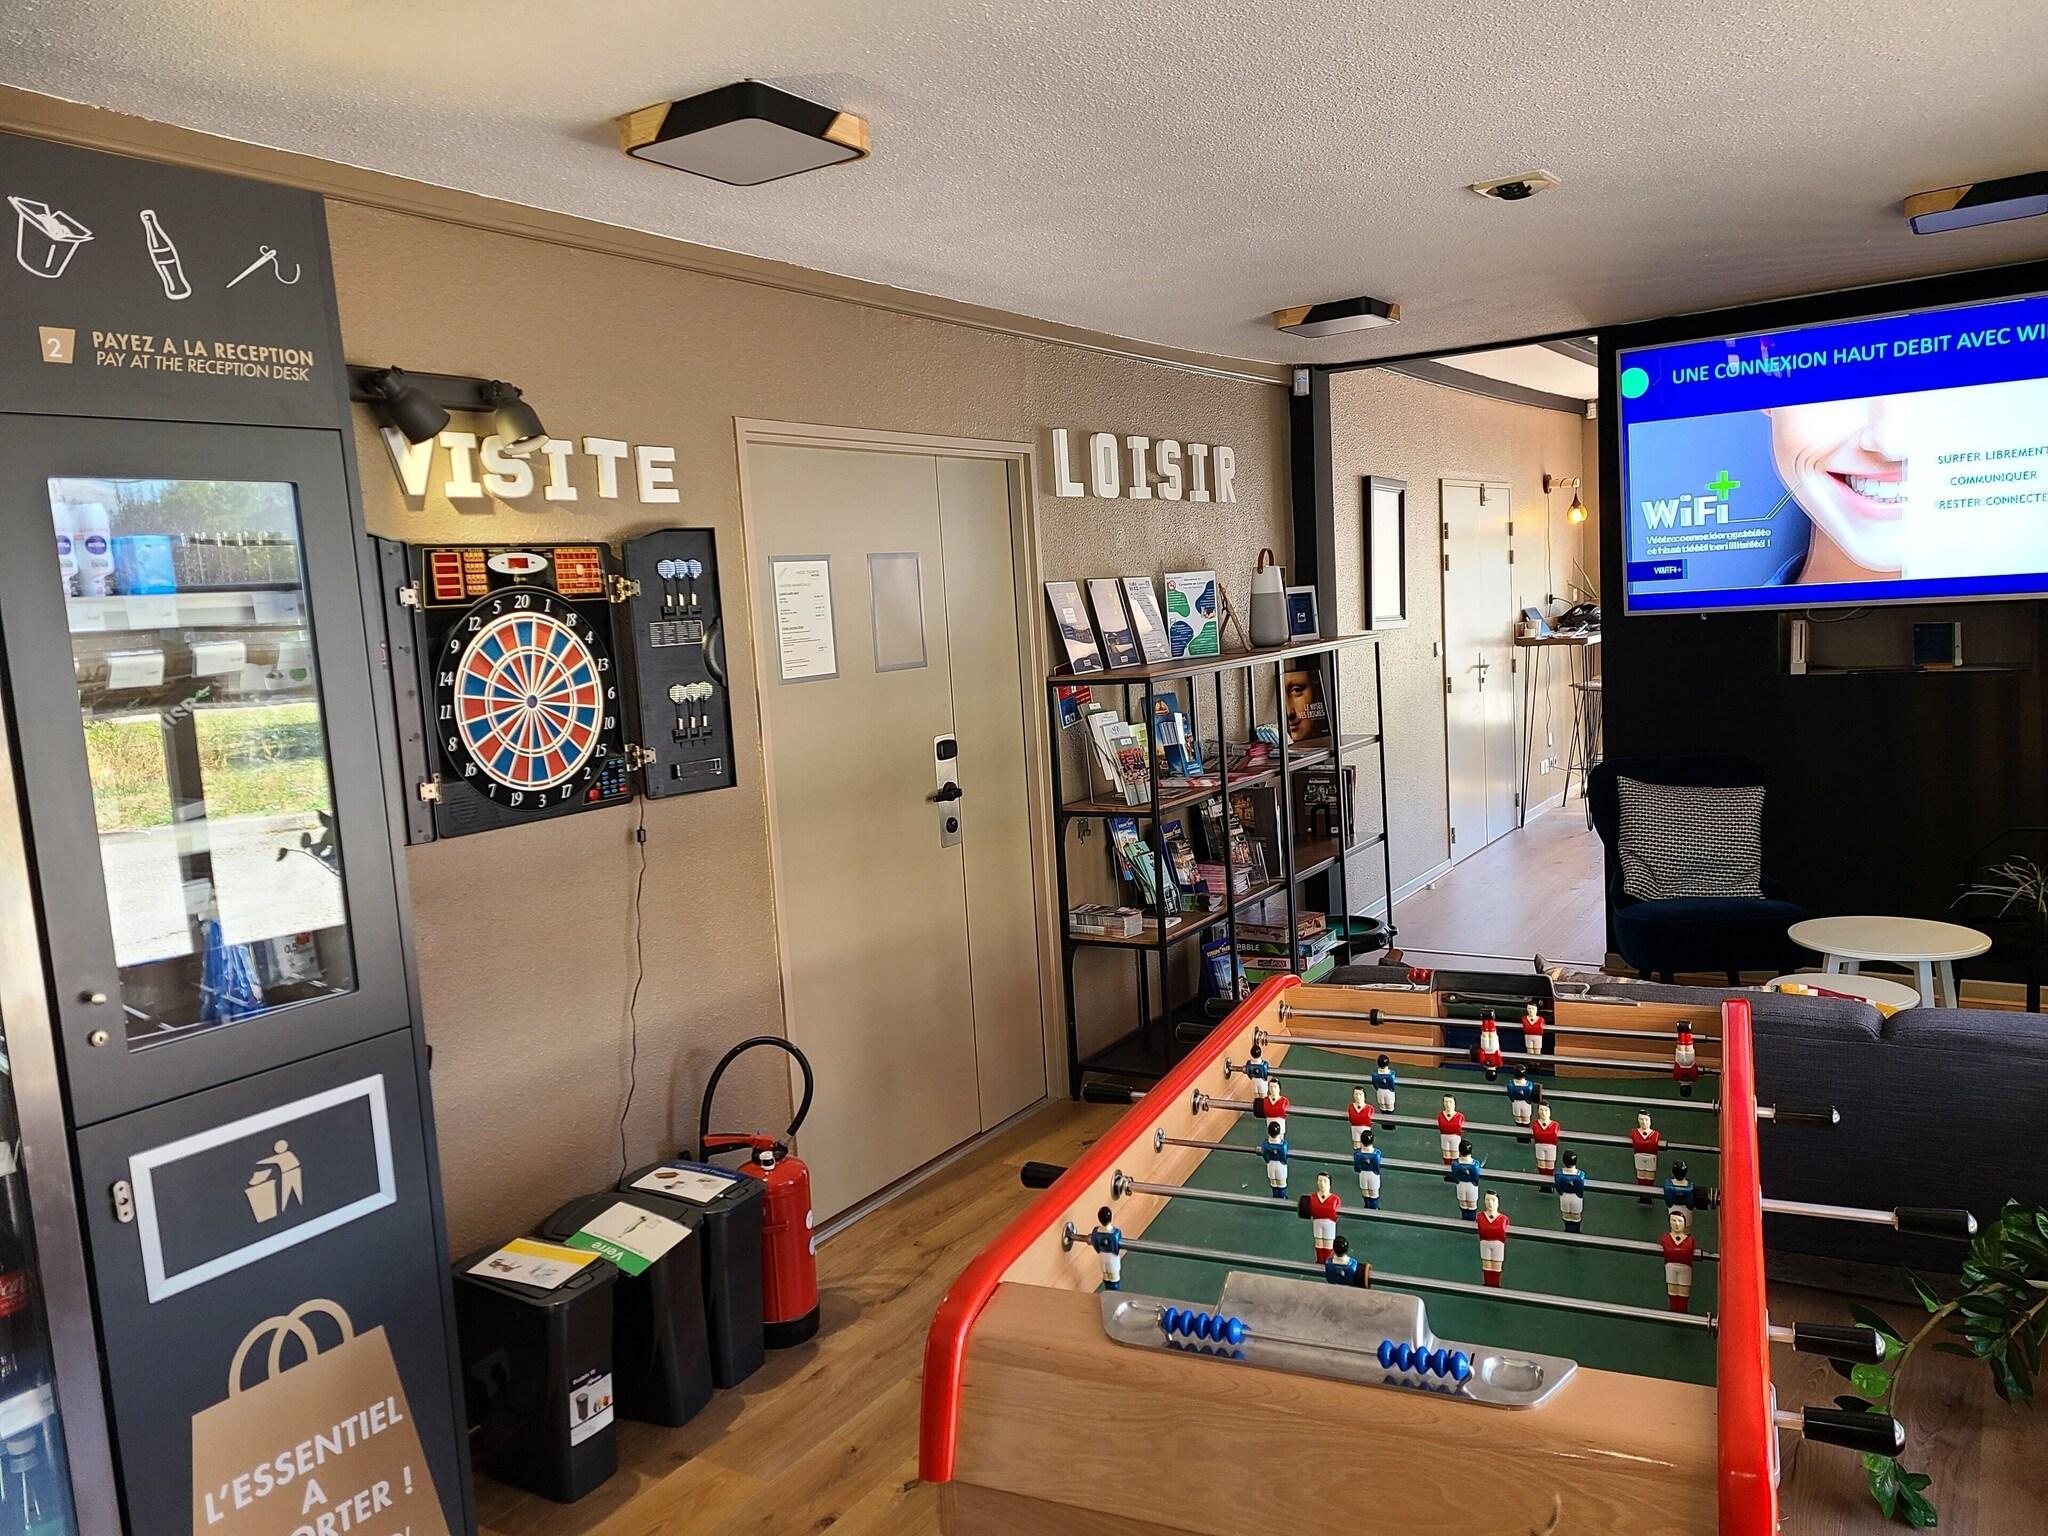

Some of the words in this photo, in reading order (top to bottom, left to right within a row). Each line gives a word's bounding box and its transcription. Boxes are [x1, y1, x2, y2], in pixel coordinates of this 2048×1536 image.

[47, 337, 64, 359] 2
[91, 330, 155, 354] PAYEZ
[162, 337, 178, 355] A
[183, 339, 209, 358] LA
[213, 341, 315, 367] RECEPTION
[1672, 365, 1710, 385] UNE
[1714, 350, 1828, 379] CONNEXION
[1833, 343, 1889, 365] HAUT
[1894, 335, 1953, 358] DEBIT
[1957, 327, 2012, 351] AVEC
[2017, 322, 2048, 342] WI
[96, 350, 127, 368] PAY
[129, 353, 150, 370] AT
[154, 355, 184, 373] THE
[187, 357, 270, 379] RECEPTION
[272, 363, 311, 382] DESK
[379, 426, 681, 504] VISITE
[1937, 451, 1982, 465] SURFER
[1052, 428, 1237, 504] LOISIR
[1950, 470, 2038, 486] COMMUNIQUER
[1939, 497, 1982, 510] RESTER
[492, 600, 502, 615] 5
[514, 594, 531, 609] 20
[543, 598, 551, 612] 1
[467, 616, 482, 632] 12
[566, 612, 577, 627] 18
[584, 630, 594, 643] 4
[450, 639, 461, 654] 9
[597, 657, 609, 672] 13
[439, 671, 454, 687] 14
[607, 686, 616, 700] 6
[439, 704, 452, 720] 11
[603, 715, 616, 730] 10
[447, 737, 458, 752] 8
[595, 743, 607, 757] 15
[464, 761, 477, 777] 16
[583, 766, 592, 780] 2
[488, 784, 497, 798] 7
[510, 791, 523, 806] 19
[561, 784, 573, 799] 17
[538, 792, 547, 808] 3
[591, 1241, 625, 1262] Verre
[204, 1396, 404, 1526] L'ESSENTIEL
[301, 1478, 328, 1516] A
